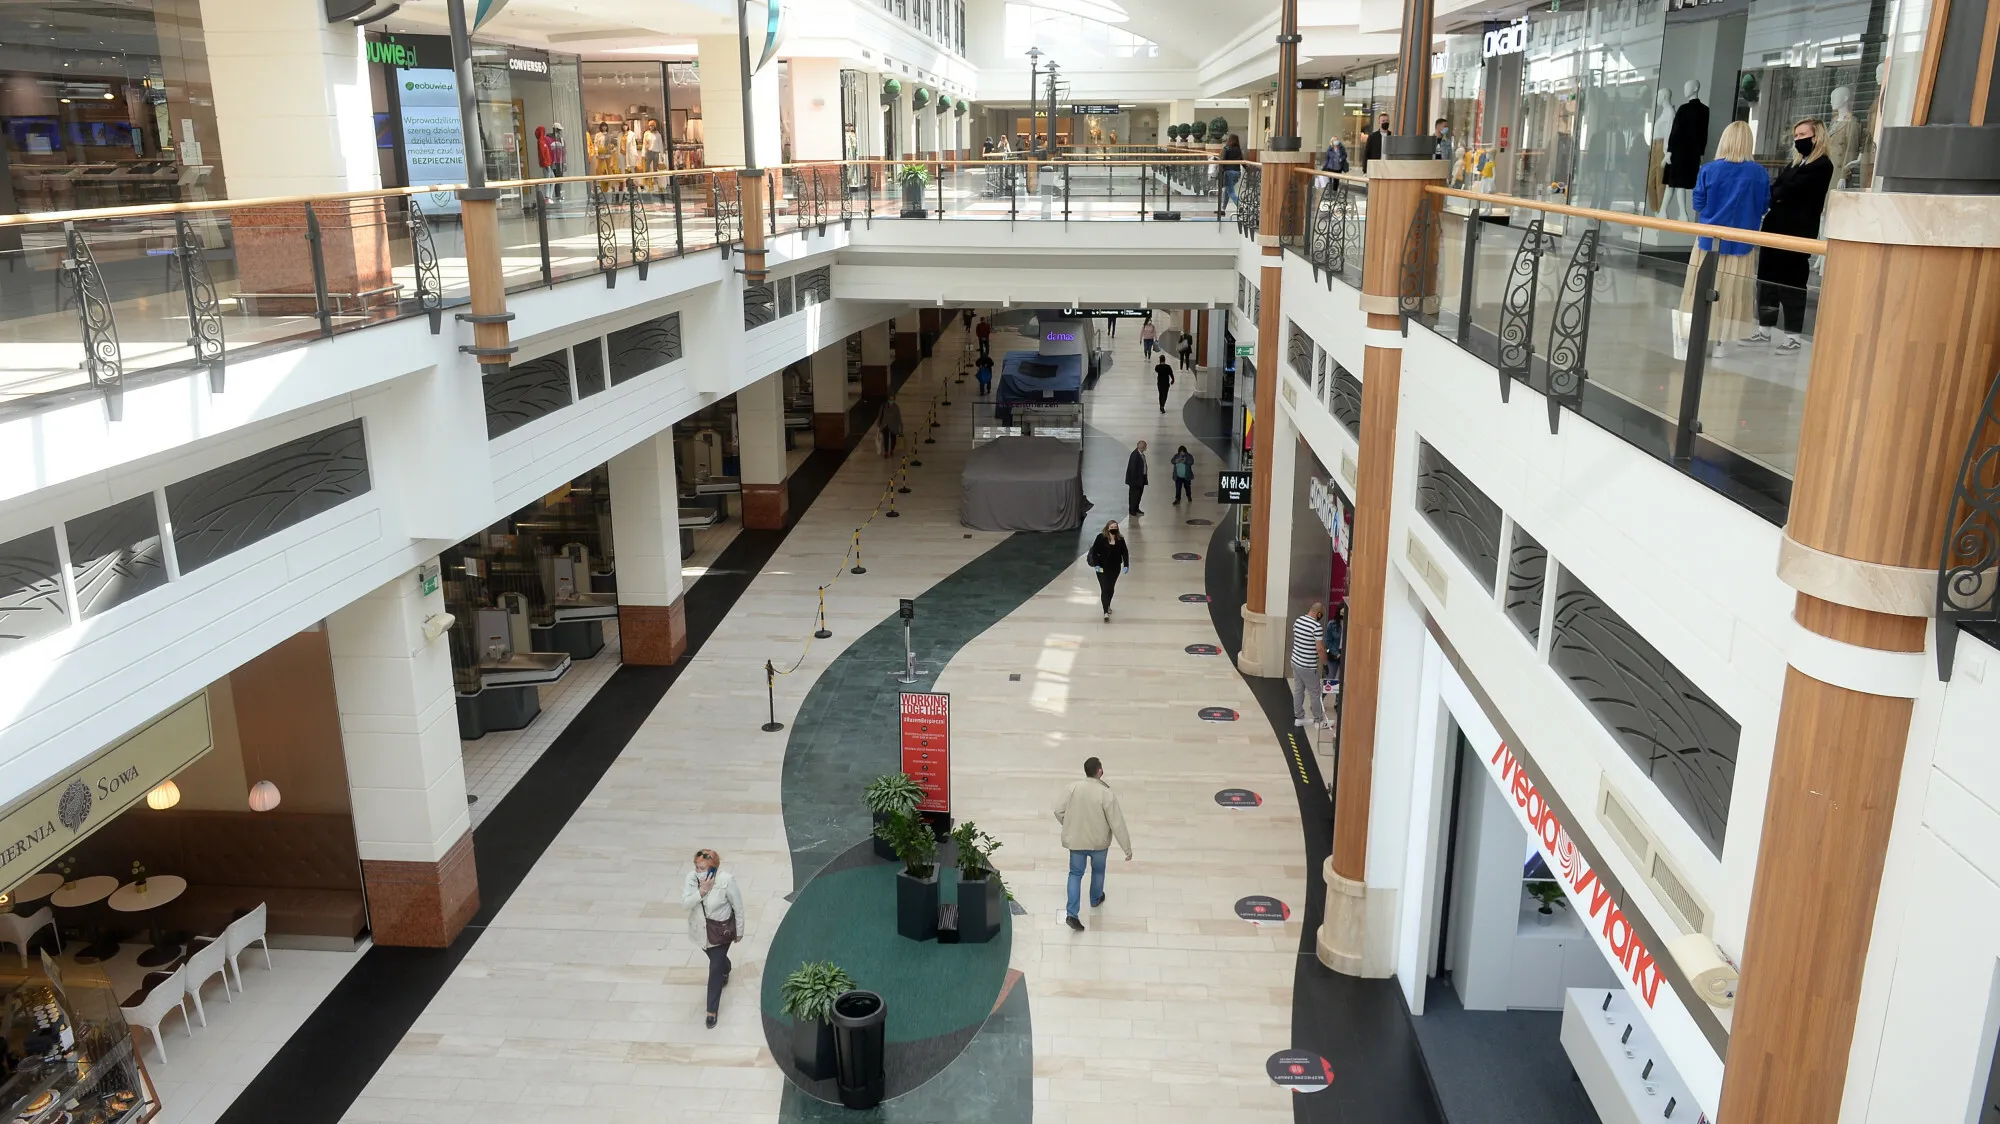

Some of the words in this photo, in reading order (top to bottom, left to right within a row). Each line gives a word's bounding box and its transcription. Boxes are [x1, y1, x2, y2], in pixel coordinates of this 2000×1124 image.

[509, 58, 543, 72] CONVERSE
[415, 82, 453, 90] eobuwie.pl
[408, 147, 434, 155] możesz
[437, 147, 453, 155] czuć
[412, 156, 463, 165] BEZPIECZNIE
[901, 694, 947, 706] WORKING
[901, 704, 948, 716] TOGETHER
[1491, 740, 1561, 856] Media
[1573, 867, 1667, 1010] Markt
